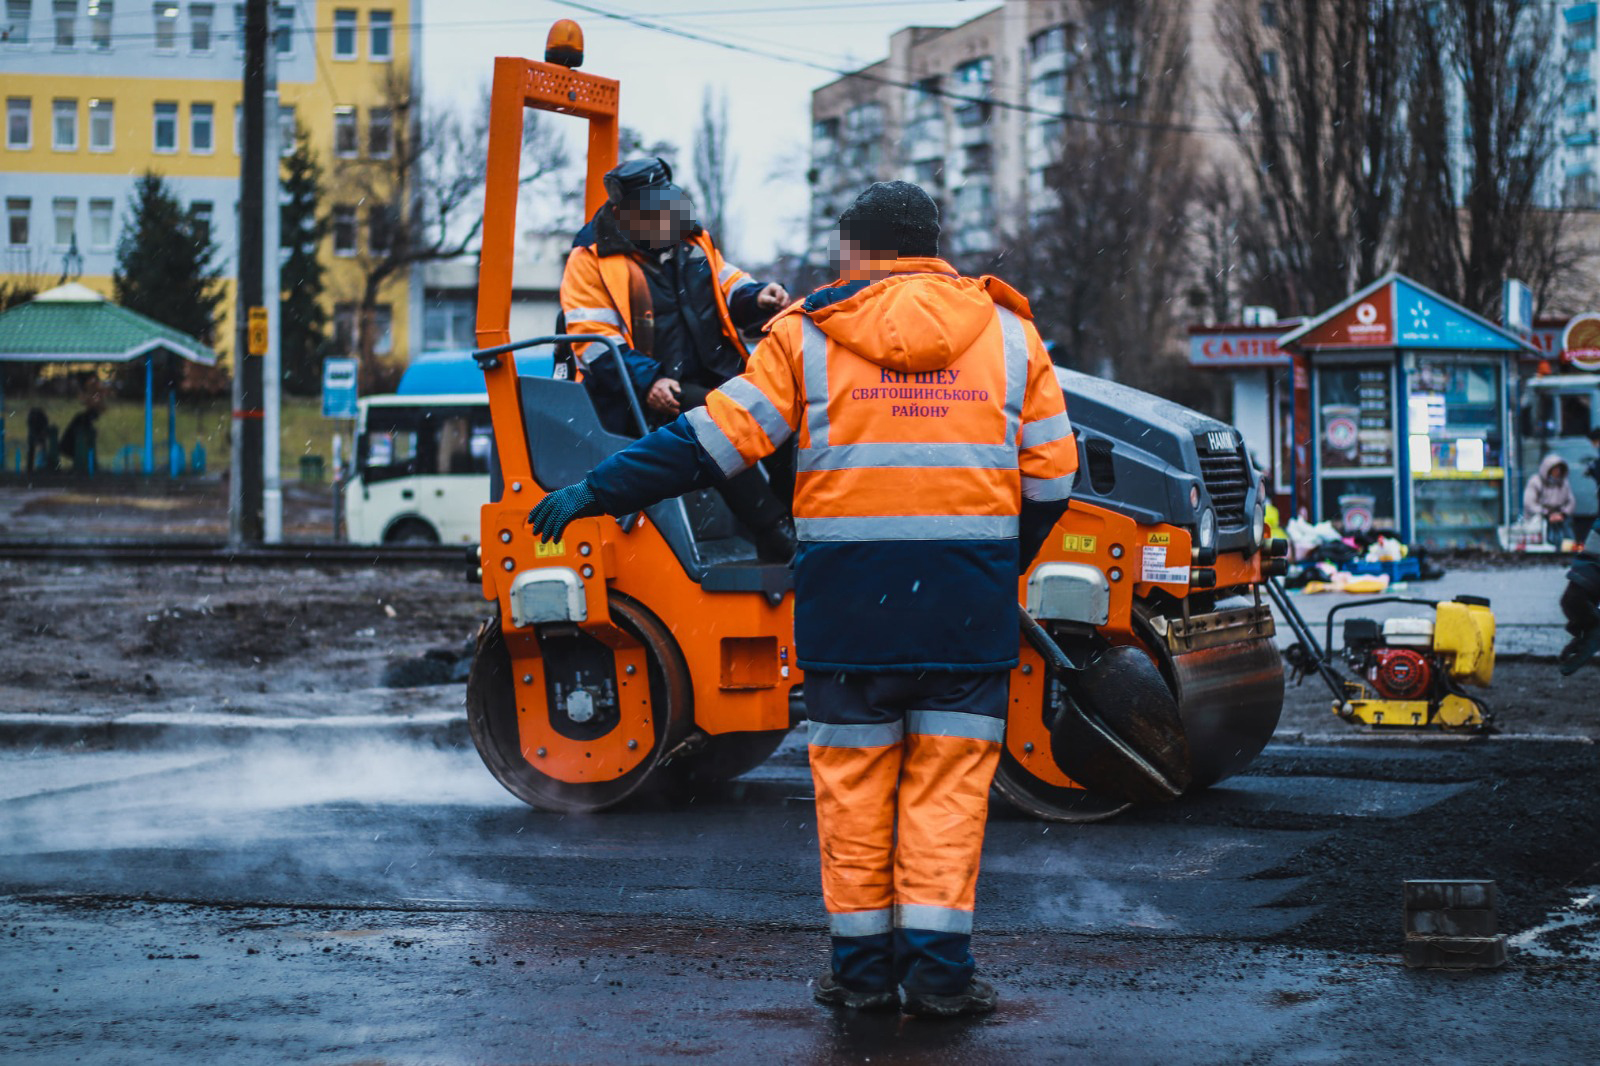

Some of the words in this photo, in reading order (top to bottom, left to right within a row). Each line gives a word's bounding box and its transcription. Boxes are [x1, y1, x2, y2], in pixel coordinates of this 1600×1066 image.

[915, 369, 960, 384] ШЕУ
[852, 387, 989, 401] СВЯТОШИНСЬКОГО
[891, 403, 950, 417] РАЙОНУ
